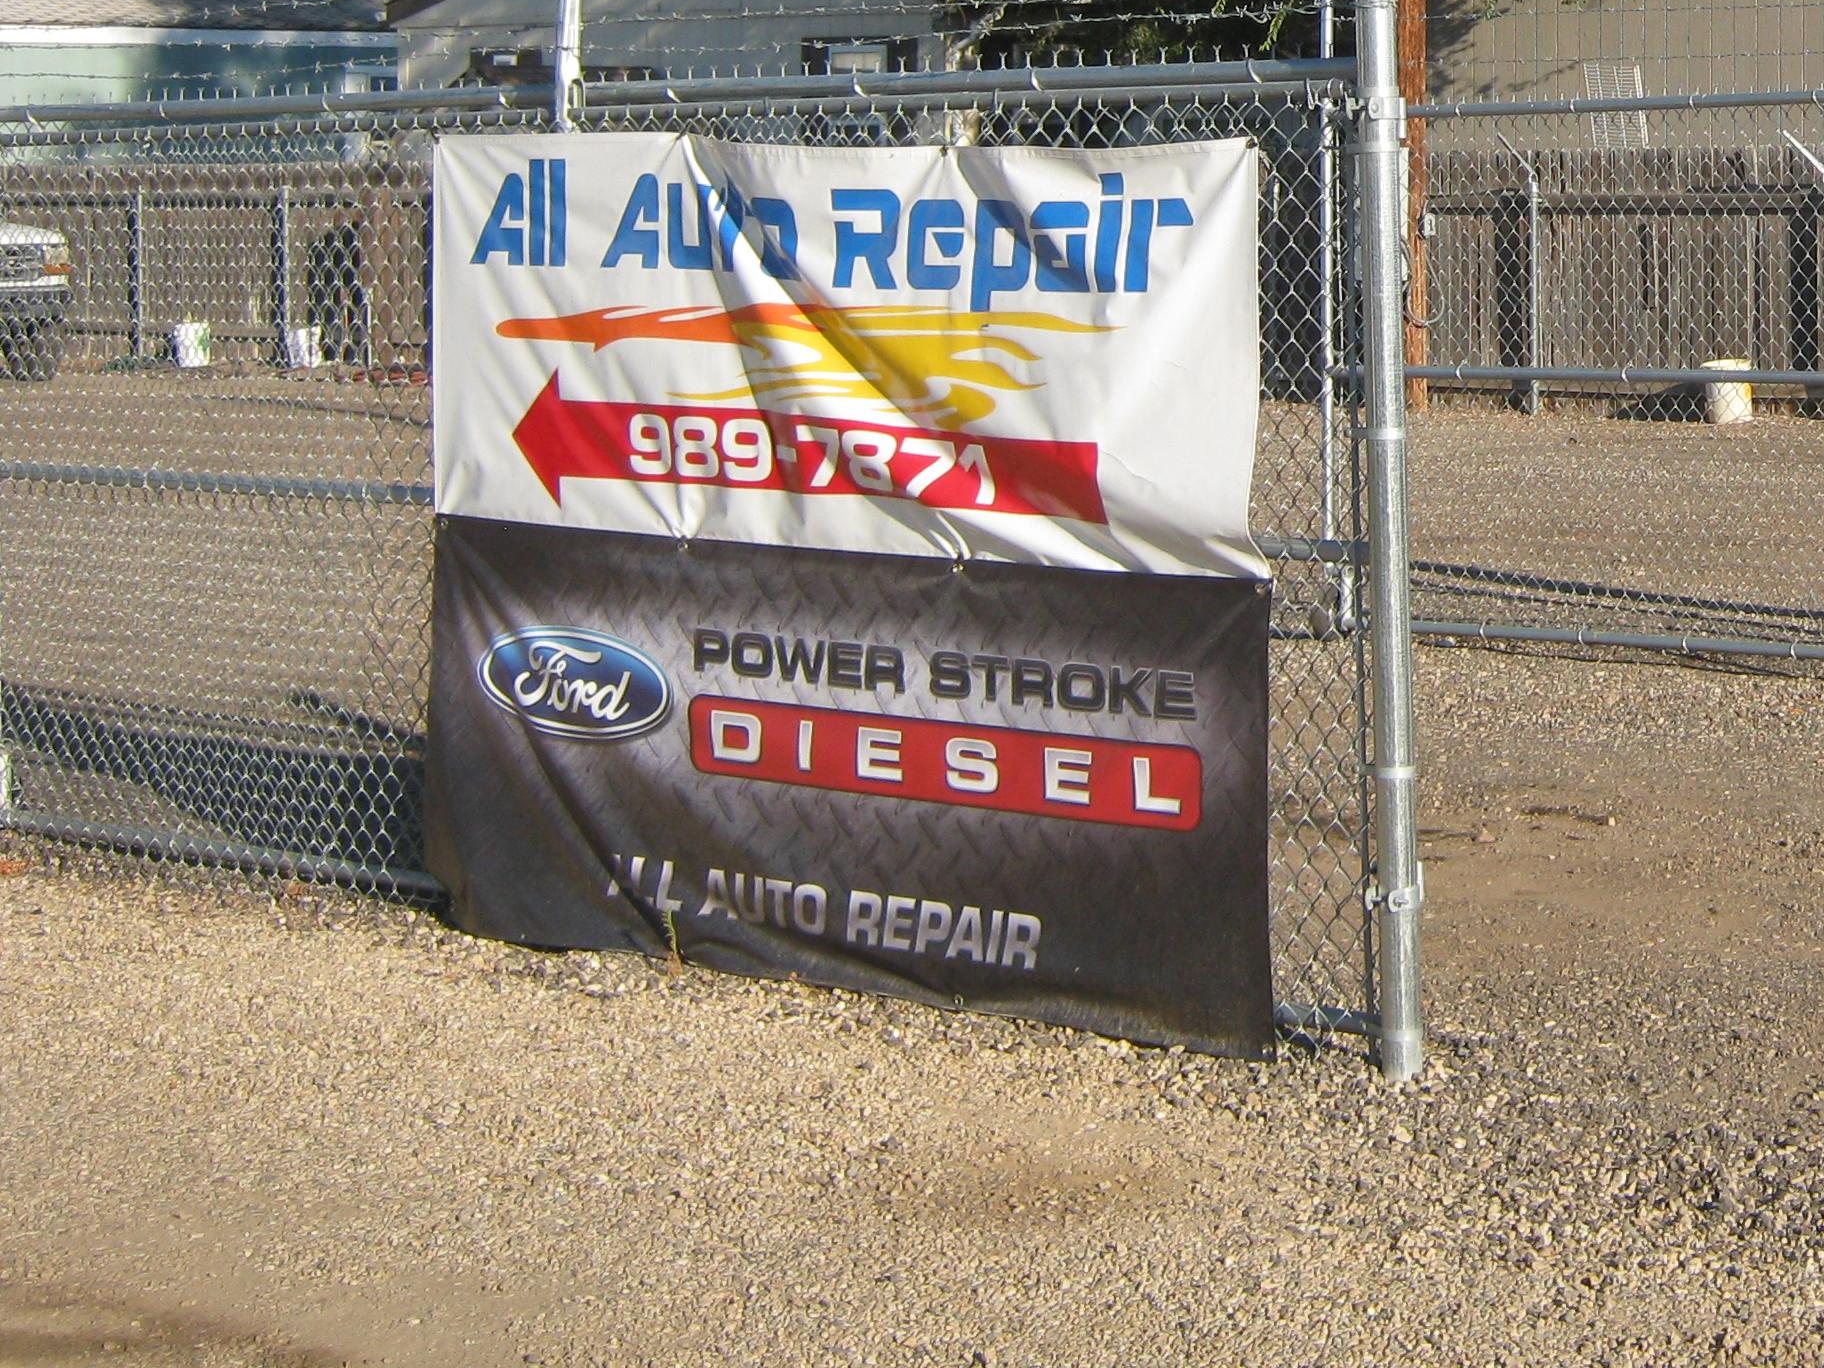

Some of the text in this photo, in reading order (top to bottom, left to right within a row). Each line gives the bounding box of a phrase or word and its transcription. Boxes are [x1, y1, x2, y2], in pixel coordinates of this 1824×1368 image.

[469, 158, 1195, 313] All Auto Repair
[628, 413, 996, 506] 989-7871
[511, 638, 632, 722] Ford
[692, 627, 1200, 721] POWER STROKE
[709, 708, 1183, 816] DIESEL
[696, 868, 828, 936] AUTO
[847, 890, 1042, 971] REPAIR
